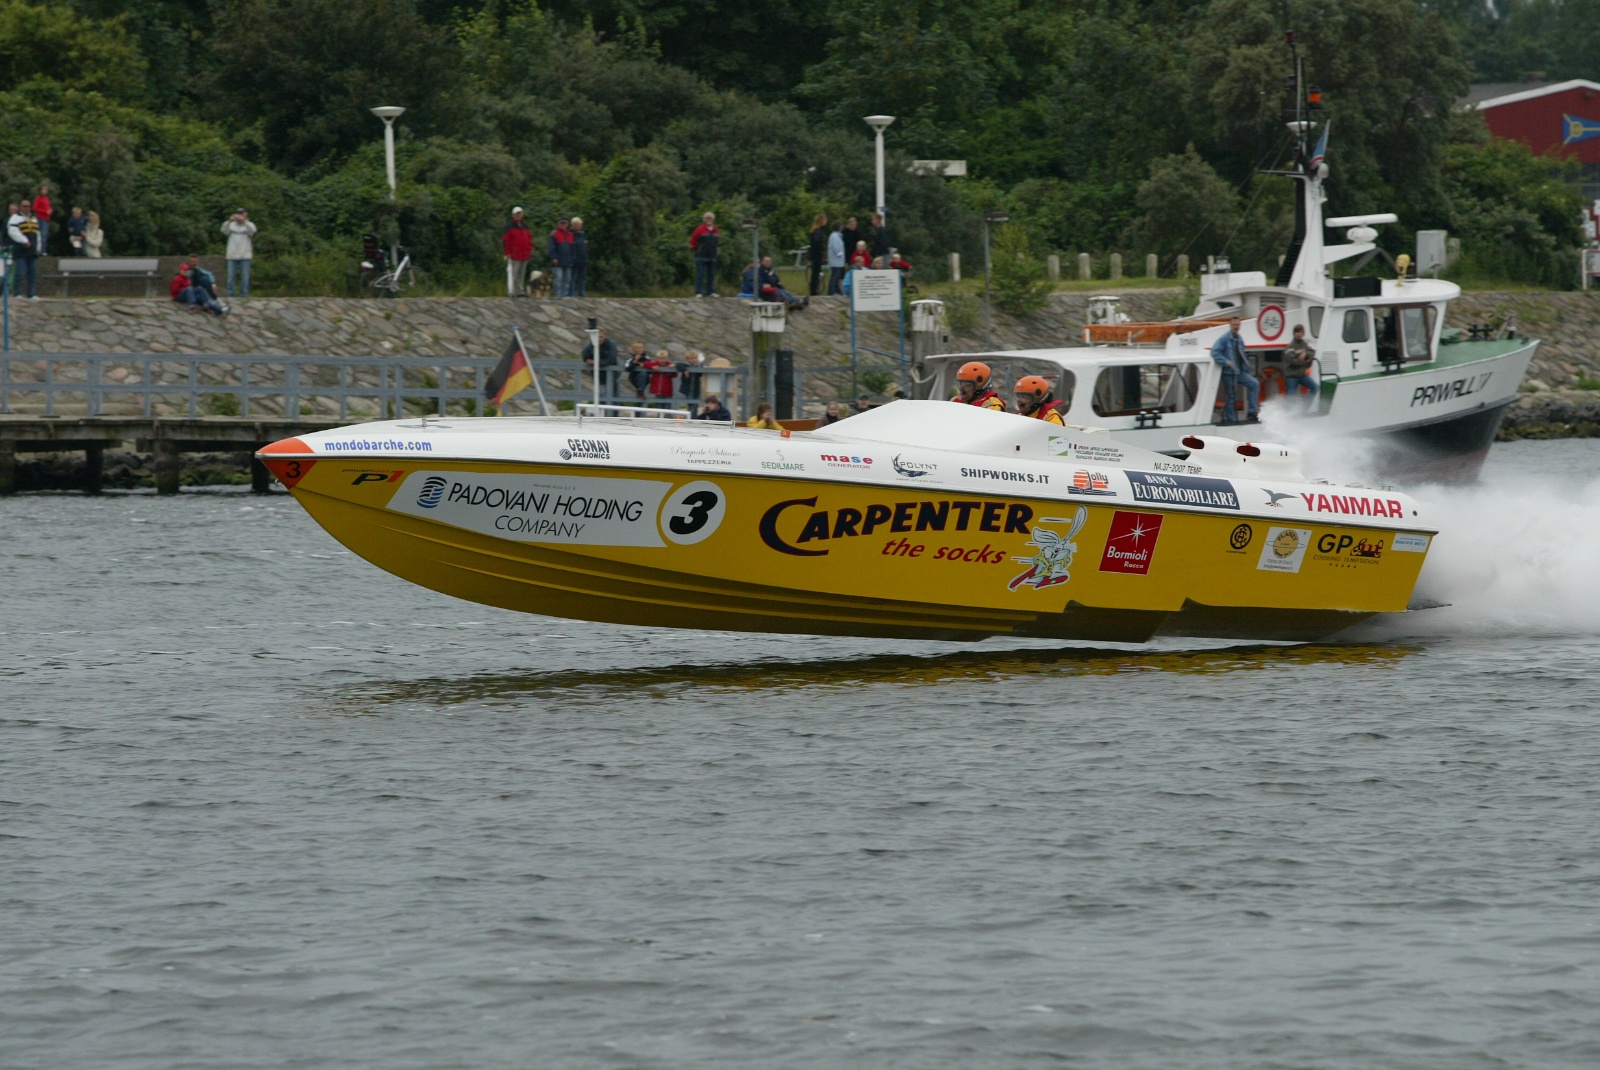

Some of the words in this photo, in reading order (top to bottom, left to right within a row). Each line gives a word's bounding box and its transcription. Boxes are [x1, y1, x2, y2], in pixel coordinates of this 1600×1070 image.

[1351, 350, 1360, 370] F
[324, 439, 433, 451] mondobarche.com
[567, 438, 610, 454] GEONAV
[572, 451, 611, 460] NAVIONICS
[820, 454, 874, 464] mase
[286, 461, 301, 478] 3
[761, 461, 805, 472] SEDILMARE
[827, 462, 871, 470] GENERATOR
[899, 461, 938, 470] POLYNT
[351, 470, 405, 486] P1
[960, 467, 1050, 485] SHIPWORKS.IT
[1144, 474, 1178, 486] BANCA
[448, 482, 549, 514] PADOVANI
[553, 495, 644, 522] HOLDING
[1132, 482, 1237, 507] EUROMOBILIARE
[669, 490, 719, 535] 3
[1299, 492, 1404, 519] YANMAR
[495, 515, 586, 538] COMPANY
[758, 495, 1034, 557] CARPENTER
[880, 537, 925, 558] the
[933, 544, 1007, 564] socks
[1106, 545, 1149, 561] Bormioli
[1123, 560, 1144, 569] Rocco
